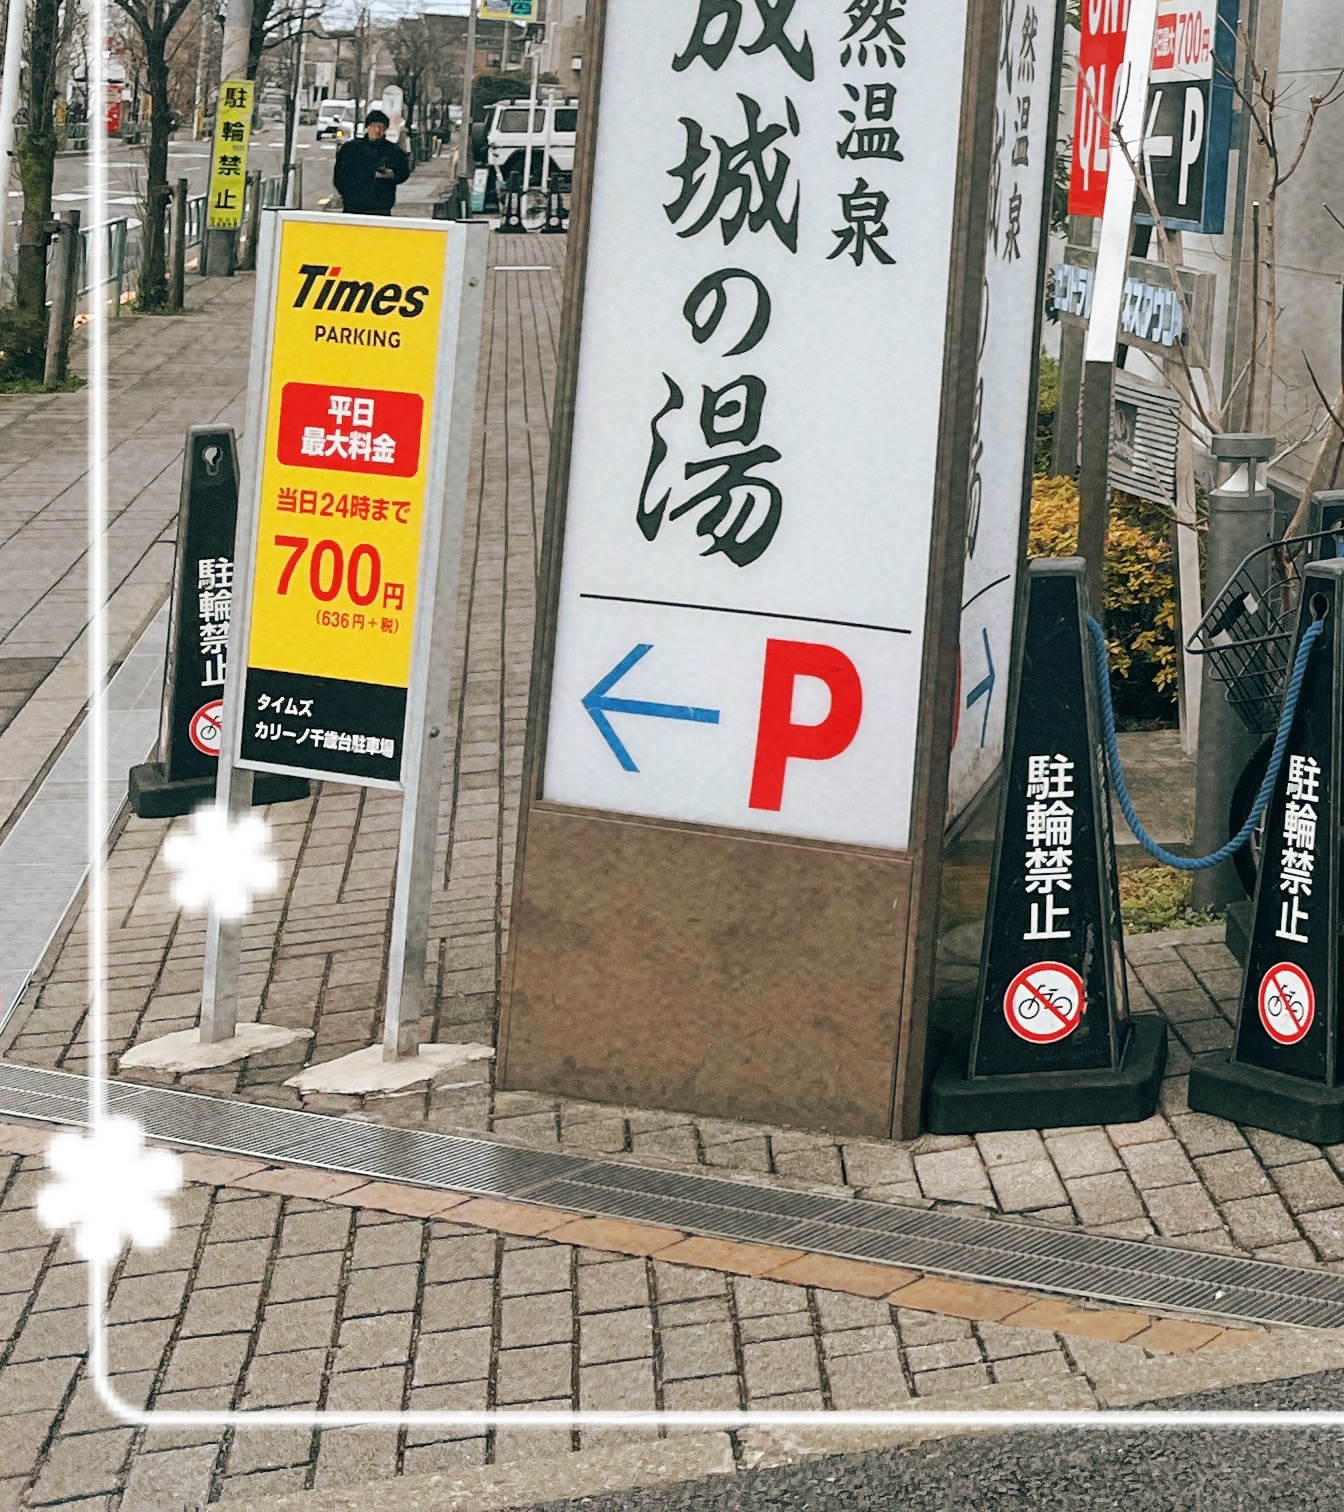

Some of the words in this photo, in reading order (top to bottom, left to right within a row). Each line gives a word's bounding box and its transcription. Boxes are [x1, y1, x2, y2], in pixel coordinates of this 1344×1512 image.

[214, 87, 248, 210] 駐輪禁止
[1178, 87, 1204, 205] P
[293, 264, 430, 318] Times
[314, 325, 401, 349] PARKING
[301, 426, 397, 464] 最大料金
[328, 395, 375, 428] 平日
[276, 487, 411, 524] 当日24時まで
[198, 557, 233, 686] 駐輪禁止
[257, 693, 314, 717] タイムズ
[748, 638, 863, 811] P
[1024, 754, 1074, 941] 駐輪禁止
[1274, 755, 1320, 944] 駐輪禁止
